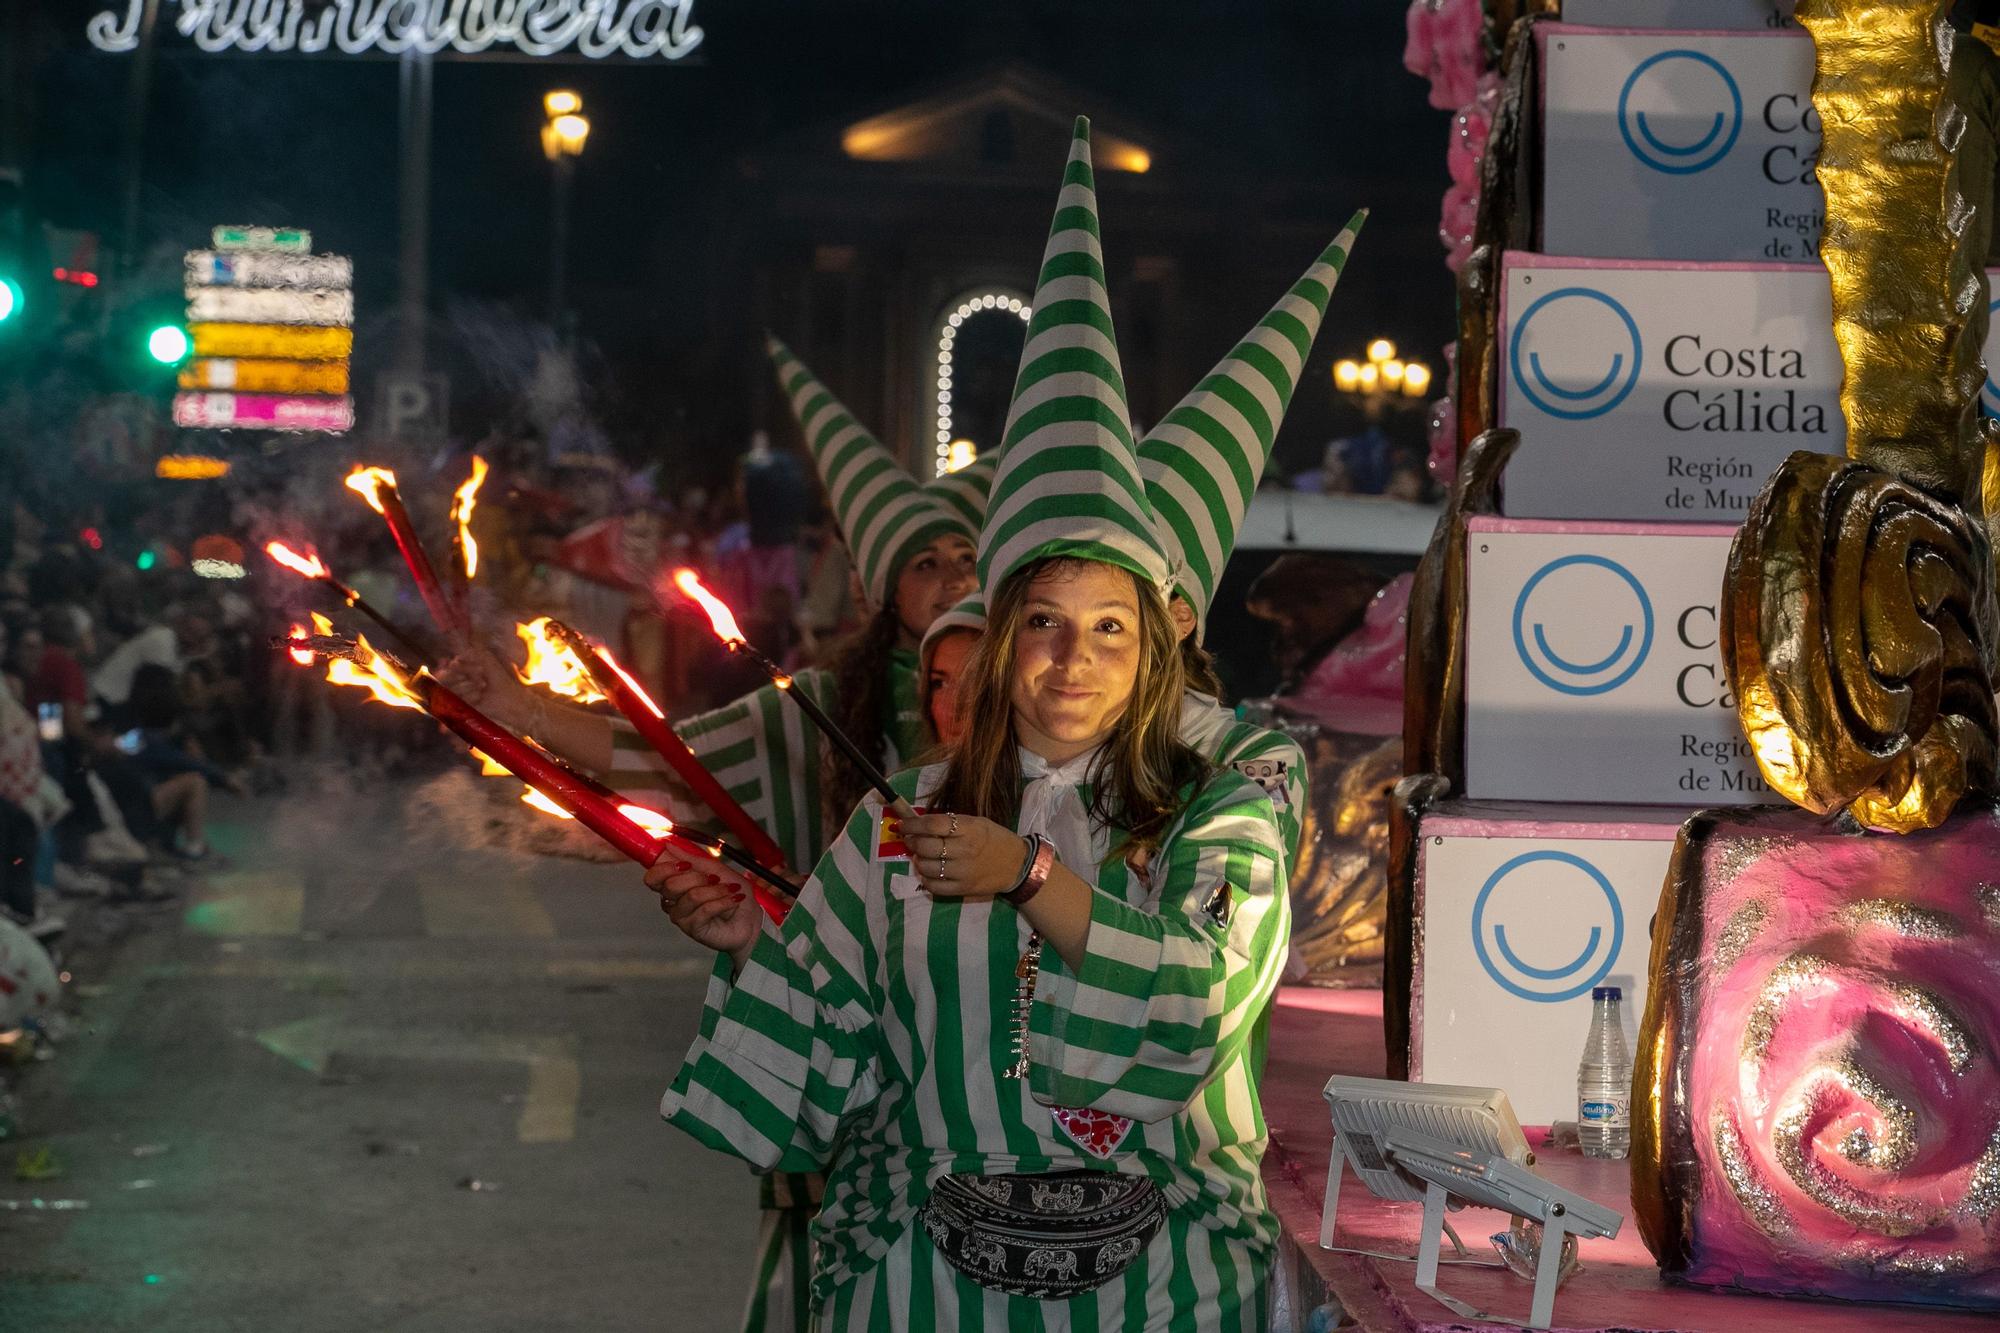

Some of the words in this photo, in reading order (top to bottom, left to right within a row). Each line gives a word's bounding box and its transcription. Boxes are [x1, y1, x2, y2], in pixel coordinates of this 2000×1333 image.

[1764, 237, 1792, 258] de
[1664, 334, 1806, 379] Costa
[1663, 388, 1828, 433] Cálida
[1666, 455, 1753, 485] Región
[1665, 487, 1695, 509] de
[1679, 768, 1710, 791] de
